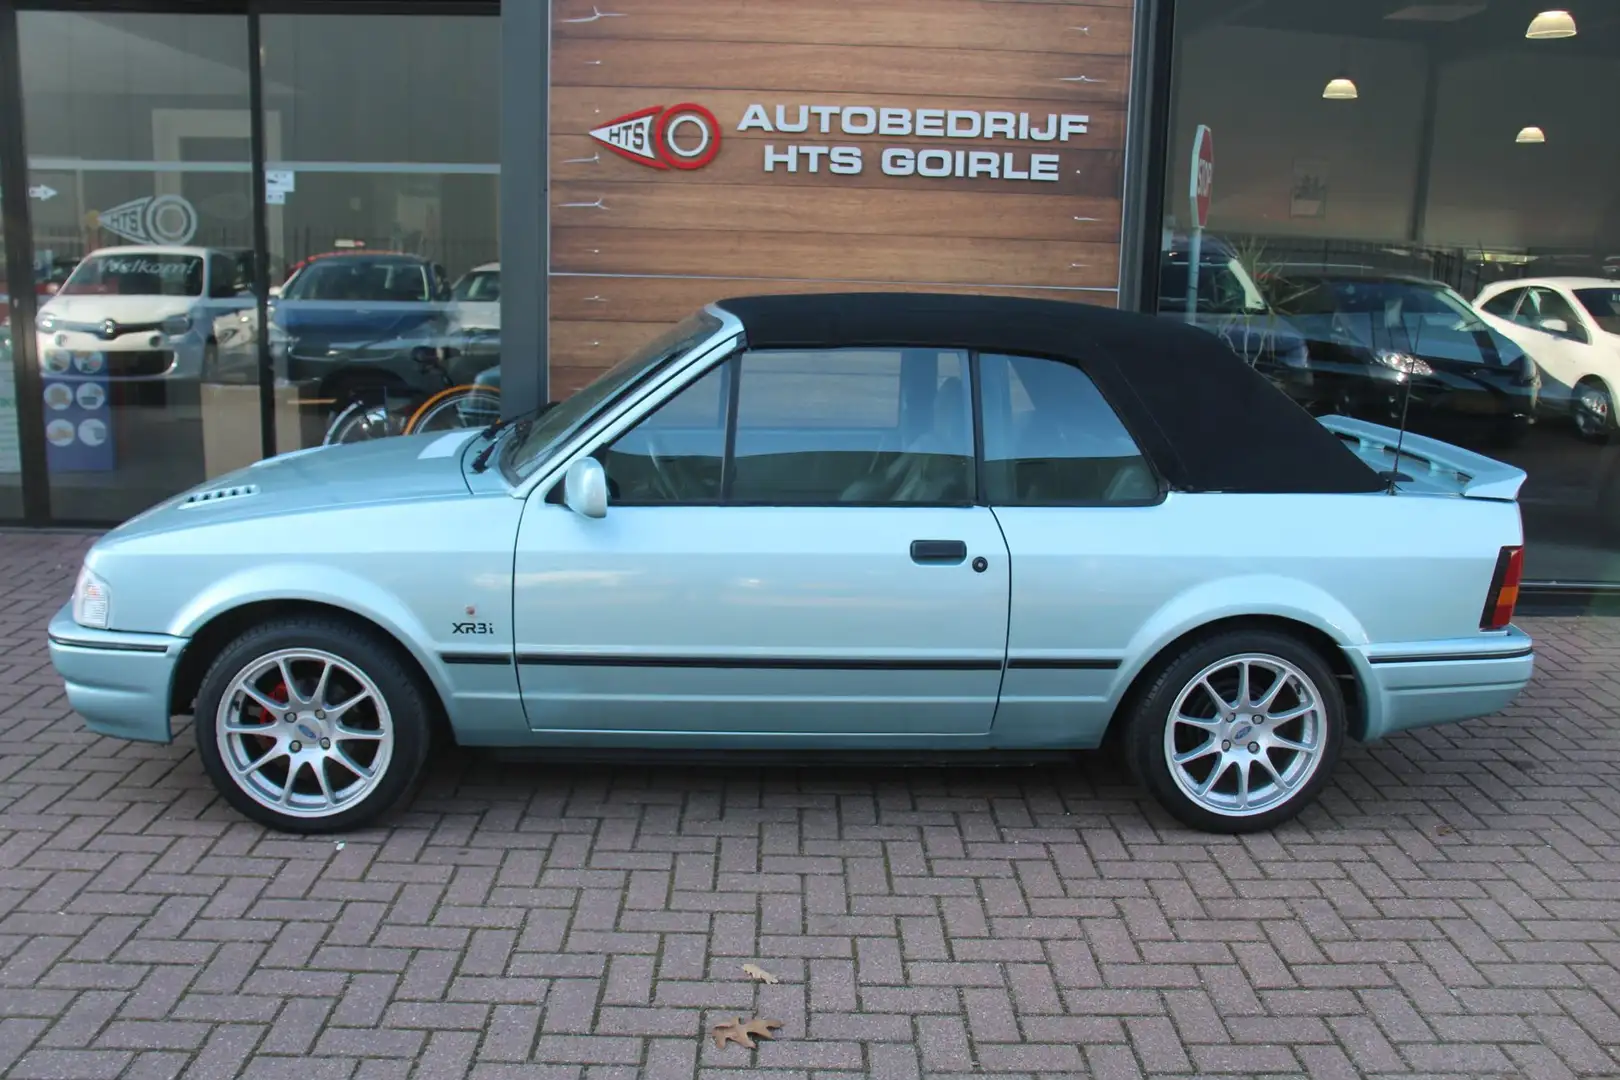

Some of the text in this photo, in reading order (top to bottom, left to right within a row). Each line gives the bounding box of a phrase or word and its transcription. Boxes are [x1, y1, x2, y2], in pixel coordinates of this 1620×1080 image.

[608, 121, 645, 150] HTS
[736, 103, 1090, 142] AUTOBEDRIJF
[764, 144, 1060, 182] HTS GOIRLE
[1198, 158, 1212, 196] STOP
[110, 210, 139, 232] HTS
[99, 259, 197, 274] Welkom!
[452, 622, 494, 634] XR3i
